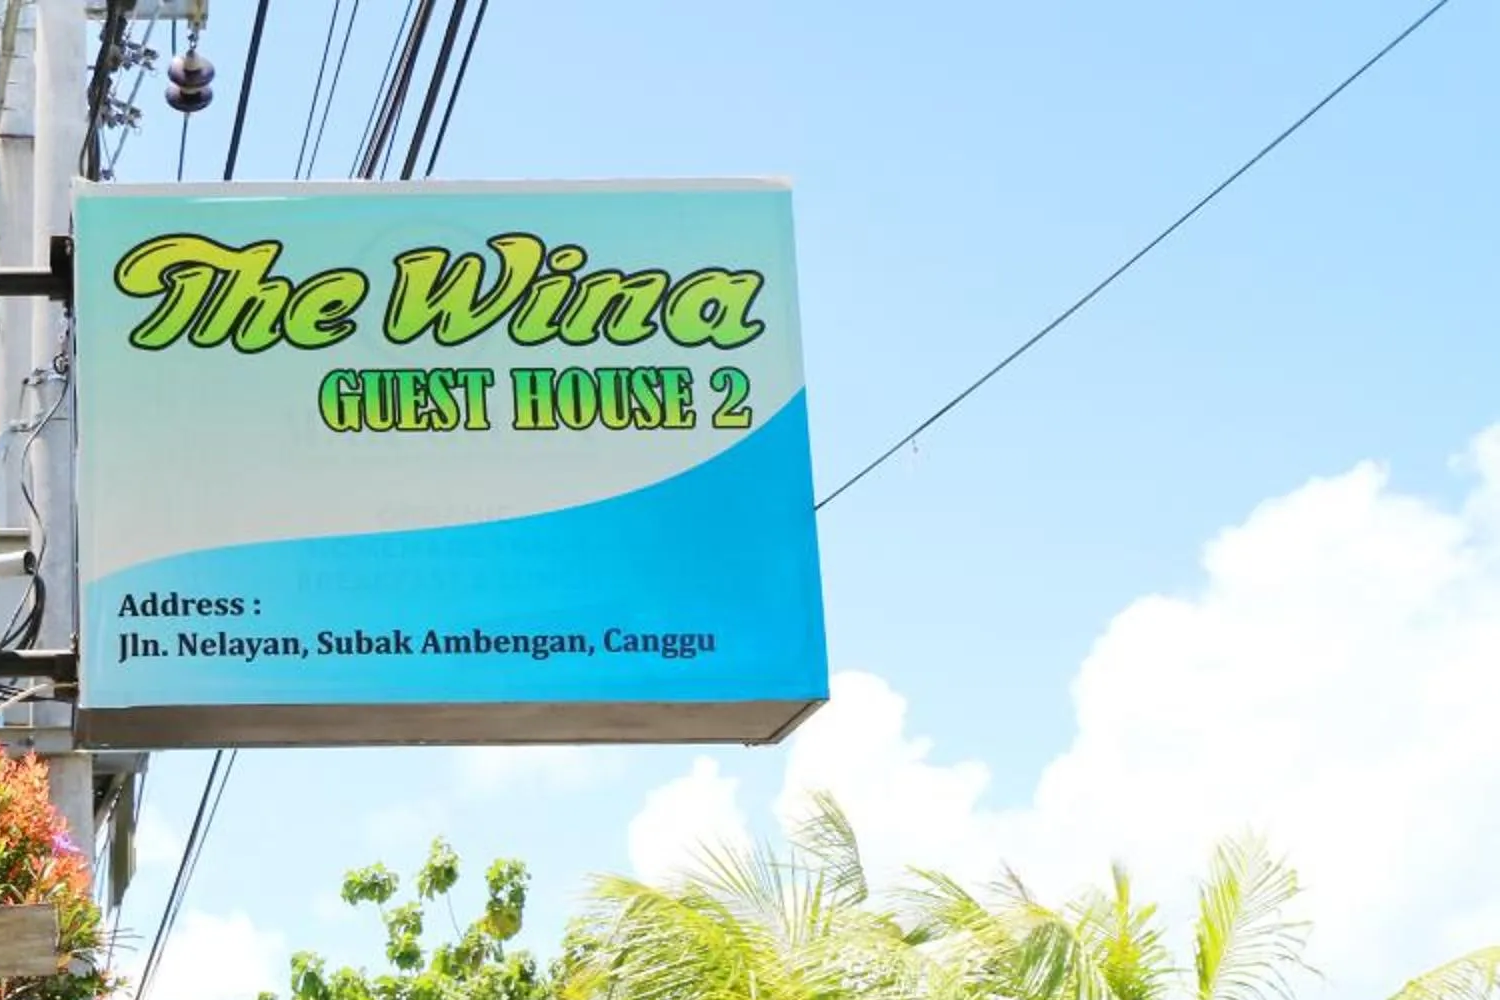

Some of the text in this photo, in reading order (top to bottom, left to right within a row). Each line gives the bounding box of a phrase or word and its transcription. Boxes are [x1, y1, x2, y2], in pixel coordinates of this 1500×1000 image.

[114, 232, 765, 353] The Wina
[318, 366, 753, 433] GUEST HOUSE 2
[118, 593, 245, 617] Address
[118, 628, 716, 661] Jln. Nelayan, Subak Ambengan, Canggu
